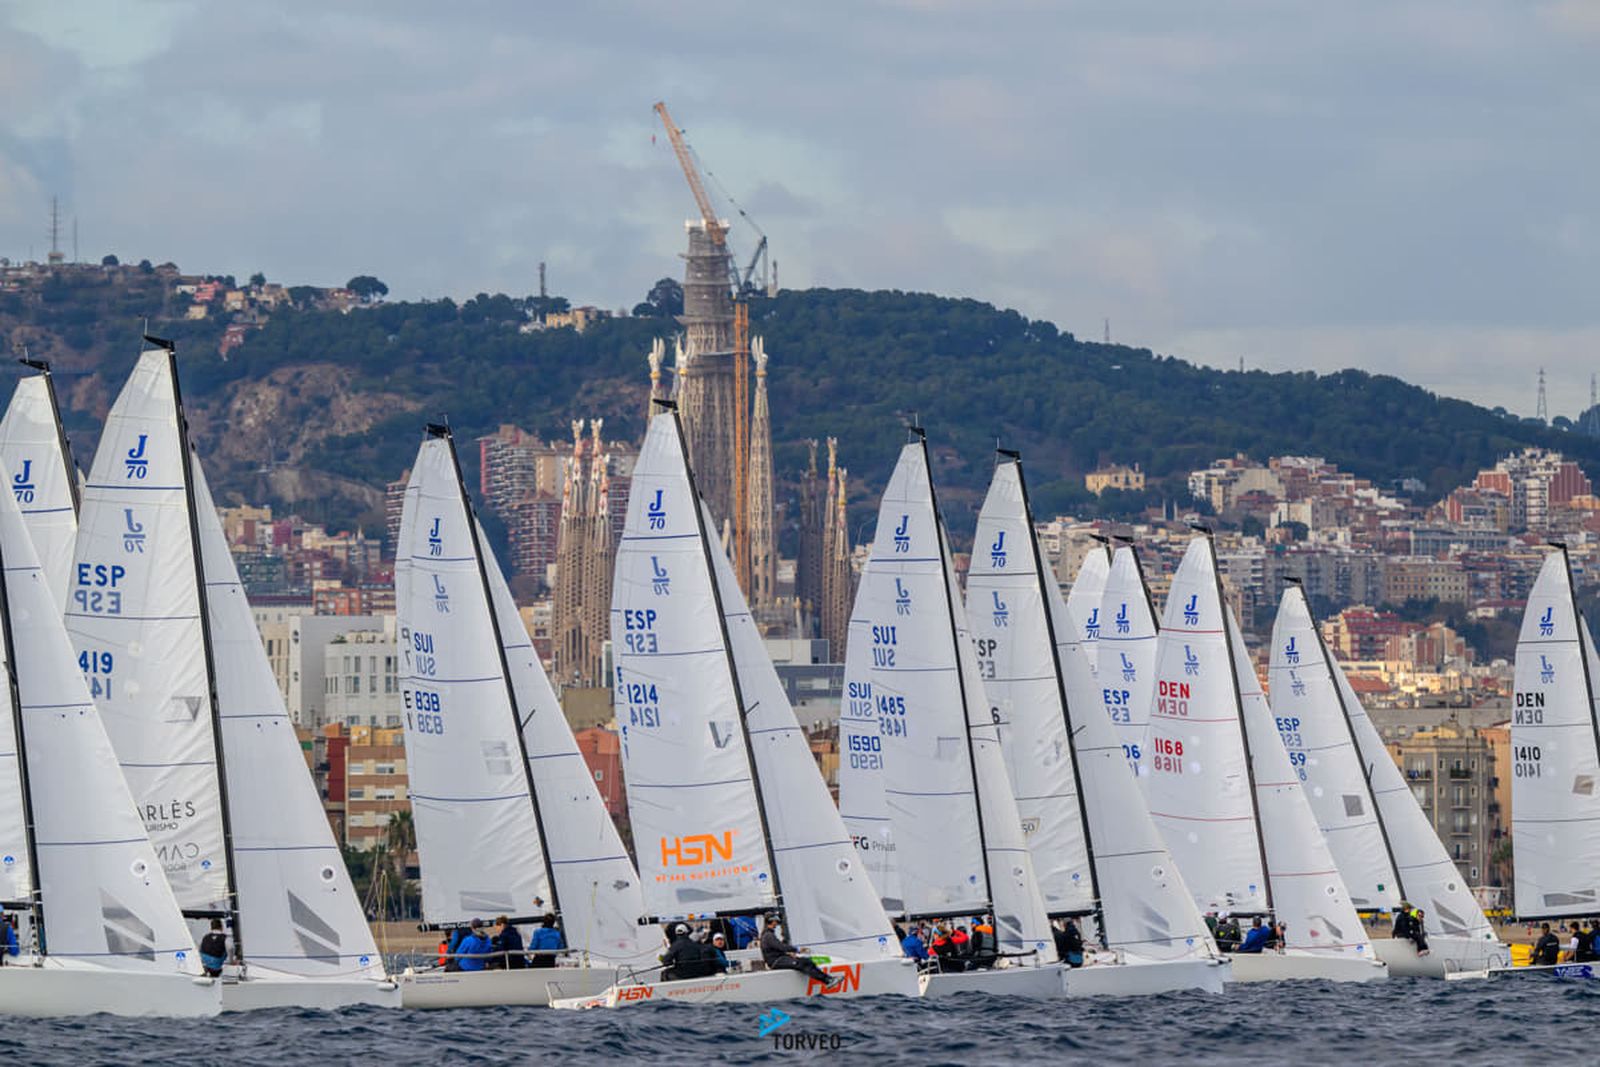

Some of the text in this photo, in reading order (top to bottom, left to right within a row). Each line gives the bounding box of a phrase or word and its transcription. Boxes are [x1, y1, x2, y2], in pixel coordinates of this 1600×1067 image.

[128, 435, 148, 459] J
[14, 460, 32, 483] J
[126, 466, 147, 479] 70
[15, 490, 34, 503] 70
[649, 490, 664, 511] J
[430, 518, 441, 538] J
[650, 518, 665, 530] 70
[896, 515, 909, 535] J
[430, 544, 442, 556] 70
[896, 541, 909, 553] 70
[992, 532, 1005, 552] J
[991, 557, 1006, 568] 70
[78, 563, 126, 588] ESP
[1185, 595, 1198, 611] J
[625, 609, 657, 630] ESP
[1088, 608, 1099, 624] J
[1117, 603, 1126, 620] J
[1541, 607, 1553, 623] J
[1117, 624, 1129, 633] 70
[1185, 615, 1198, 626] 70
[872, 626, 897, 645] SUI
[1086, 629, 1099, 639] 70
[1540, 627, 1553, 636] 70
[414, 632, 434, 654] SUI
[972, 639, 997, 657] SP
[1286, 637, 1296, 651] J
[1287, 655, 1300, 664] 70
[627, 684, 659, 705] 1214
[849, 682, 872, 699] SUI
[1103, 689, 1130, 705] ESP
[1159, 680, 1190, 699] DEN
[415, 691, 440, 712] 838
[876, 696, 906, 716] 1485
[1516, 692, 1545, 707] DEN
[1276, 717, 1300, 732] ESP
[848, 735, 881, 751] 1590
[1154, 737, 1183, 756] 1168
[1515, 746, 1541, 761] 1410
[660, 832, 733, 868] HSN
[617, 986, 654, 1002] HSN
